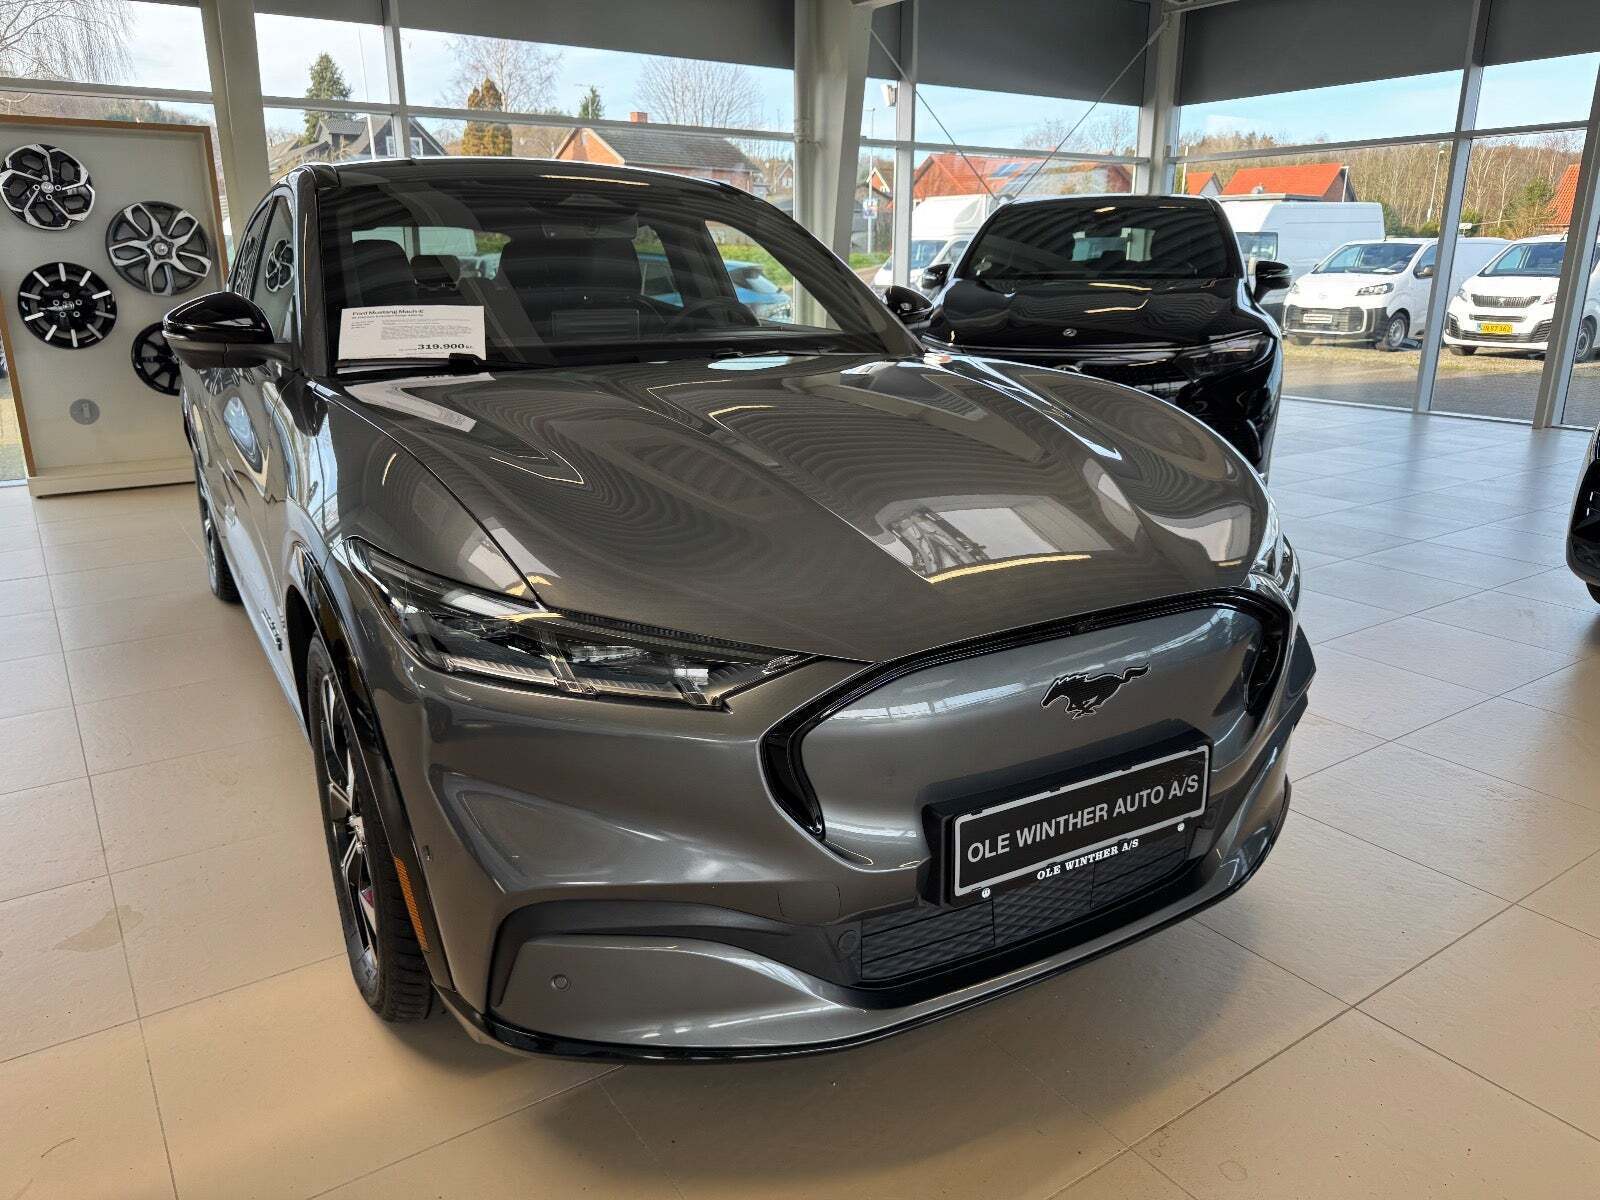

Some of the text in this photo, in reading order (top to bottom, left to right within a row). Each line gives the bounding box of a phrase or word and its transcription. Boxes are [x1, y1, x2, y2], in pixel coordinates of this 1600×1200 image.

[967, 774, 1199, 863] OLE WINTHER AUTO A/S
[1036, 838, 1139, 880] OLE WINTHER A/S
